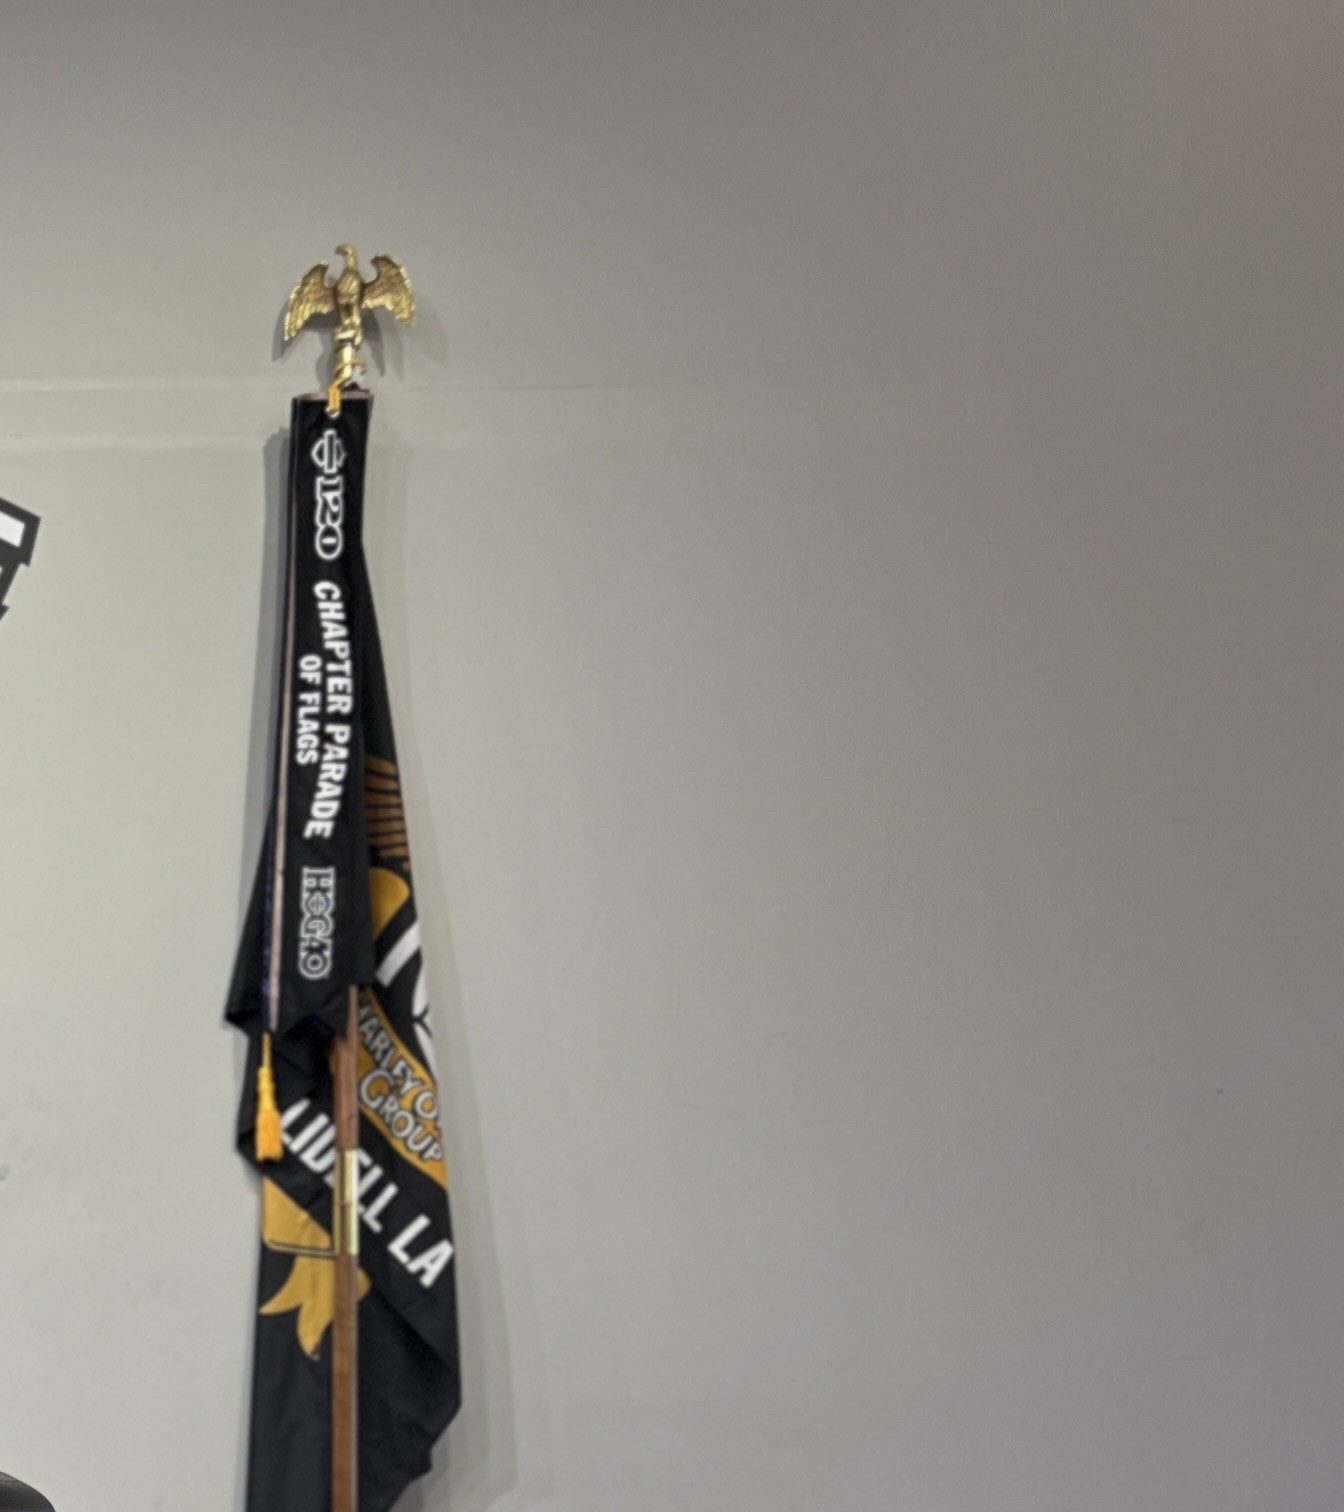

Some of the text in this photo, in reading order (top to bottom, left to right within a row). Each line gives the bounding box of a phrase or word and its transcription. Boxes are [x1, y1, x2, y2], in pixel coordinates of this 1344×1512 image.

[295, 653, 322, 766] OF FLAGS
[302, 581, 353, 839] CHAPTER PARADE
[359, 1069, 443, 1161] GROUP
[387, 1213, 454, 1289] LA
